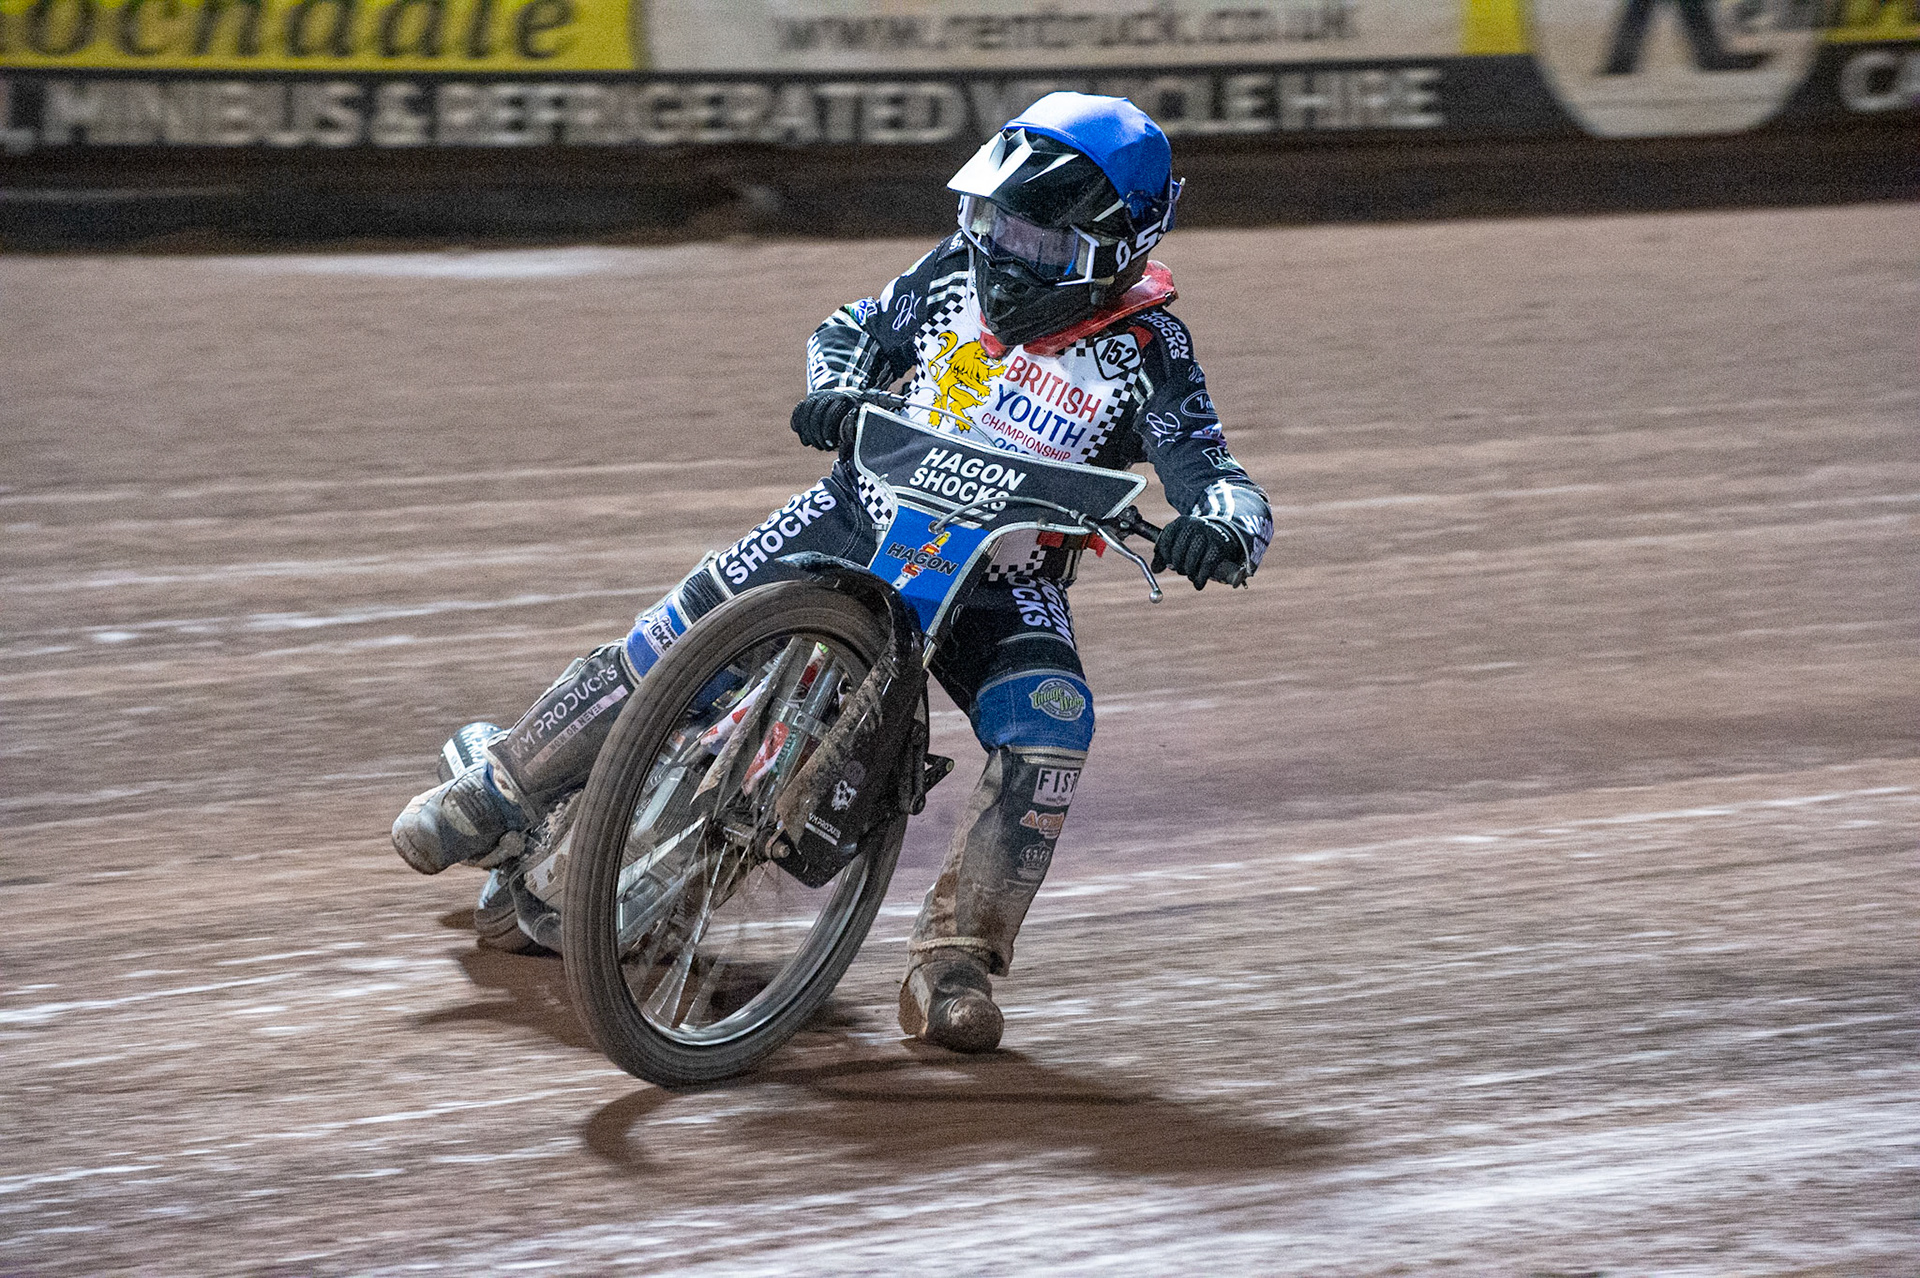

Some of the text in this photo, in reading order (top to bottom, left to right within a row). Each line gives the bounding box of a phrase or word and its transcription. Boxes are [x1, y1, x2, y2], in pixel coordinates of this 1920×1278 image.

[437, 81, 962, 146] REFRIGERATED
[1278, 66, 1444, 129] HIRE
[1098, 338, 1138, 370] 152
[1003, 355, 1103, 424] BRITISH
[981, 411, 1072, 462] CHAMPIONSHIP
[993, 384, 1087, 449] YOUTH
[908, 466, 1011, 512] SHOCKS
[920, 447, 1028, 492] HAGON
[725, 490, 838, 585] SHOCKS
[885, 541, 959, 577] HAGON
